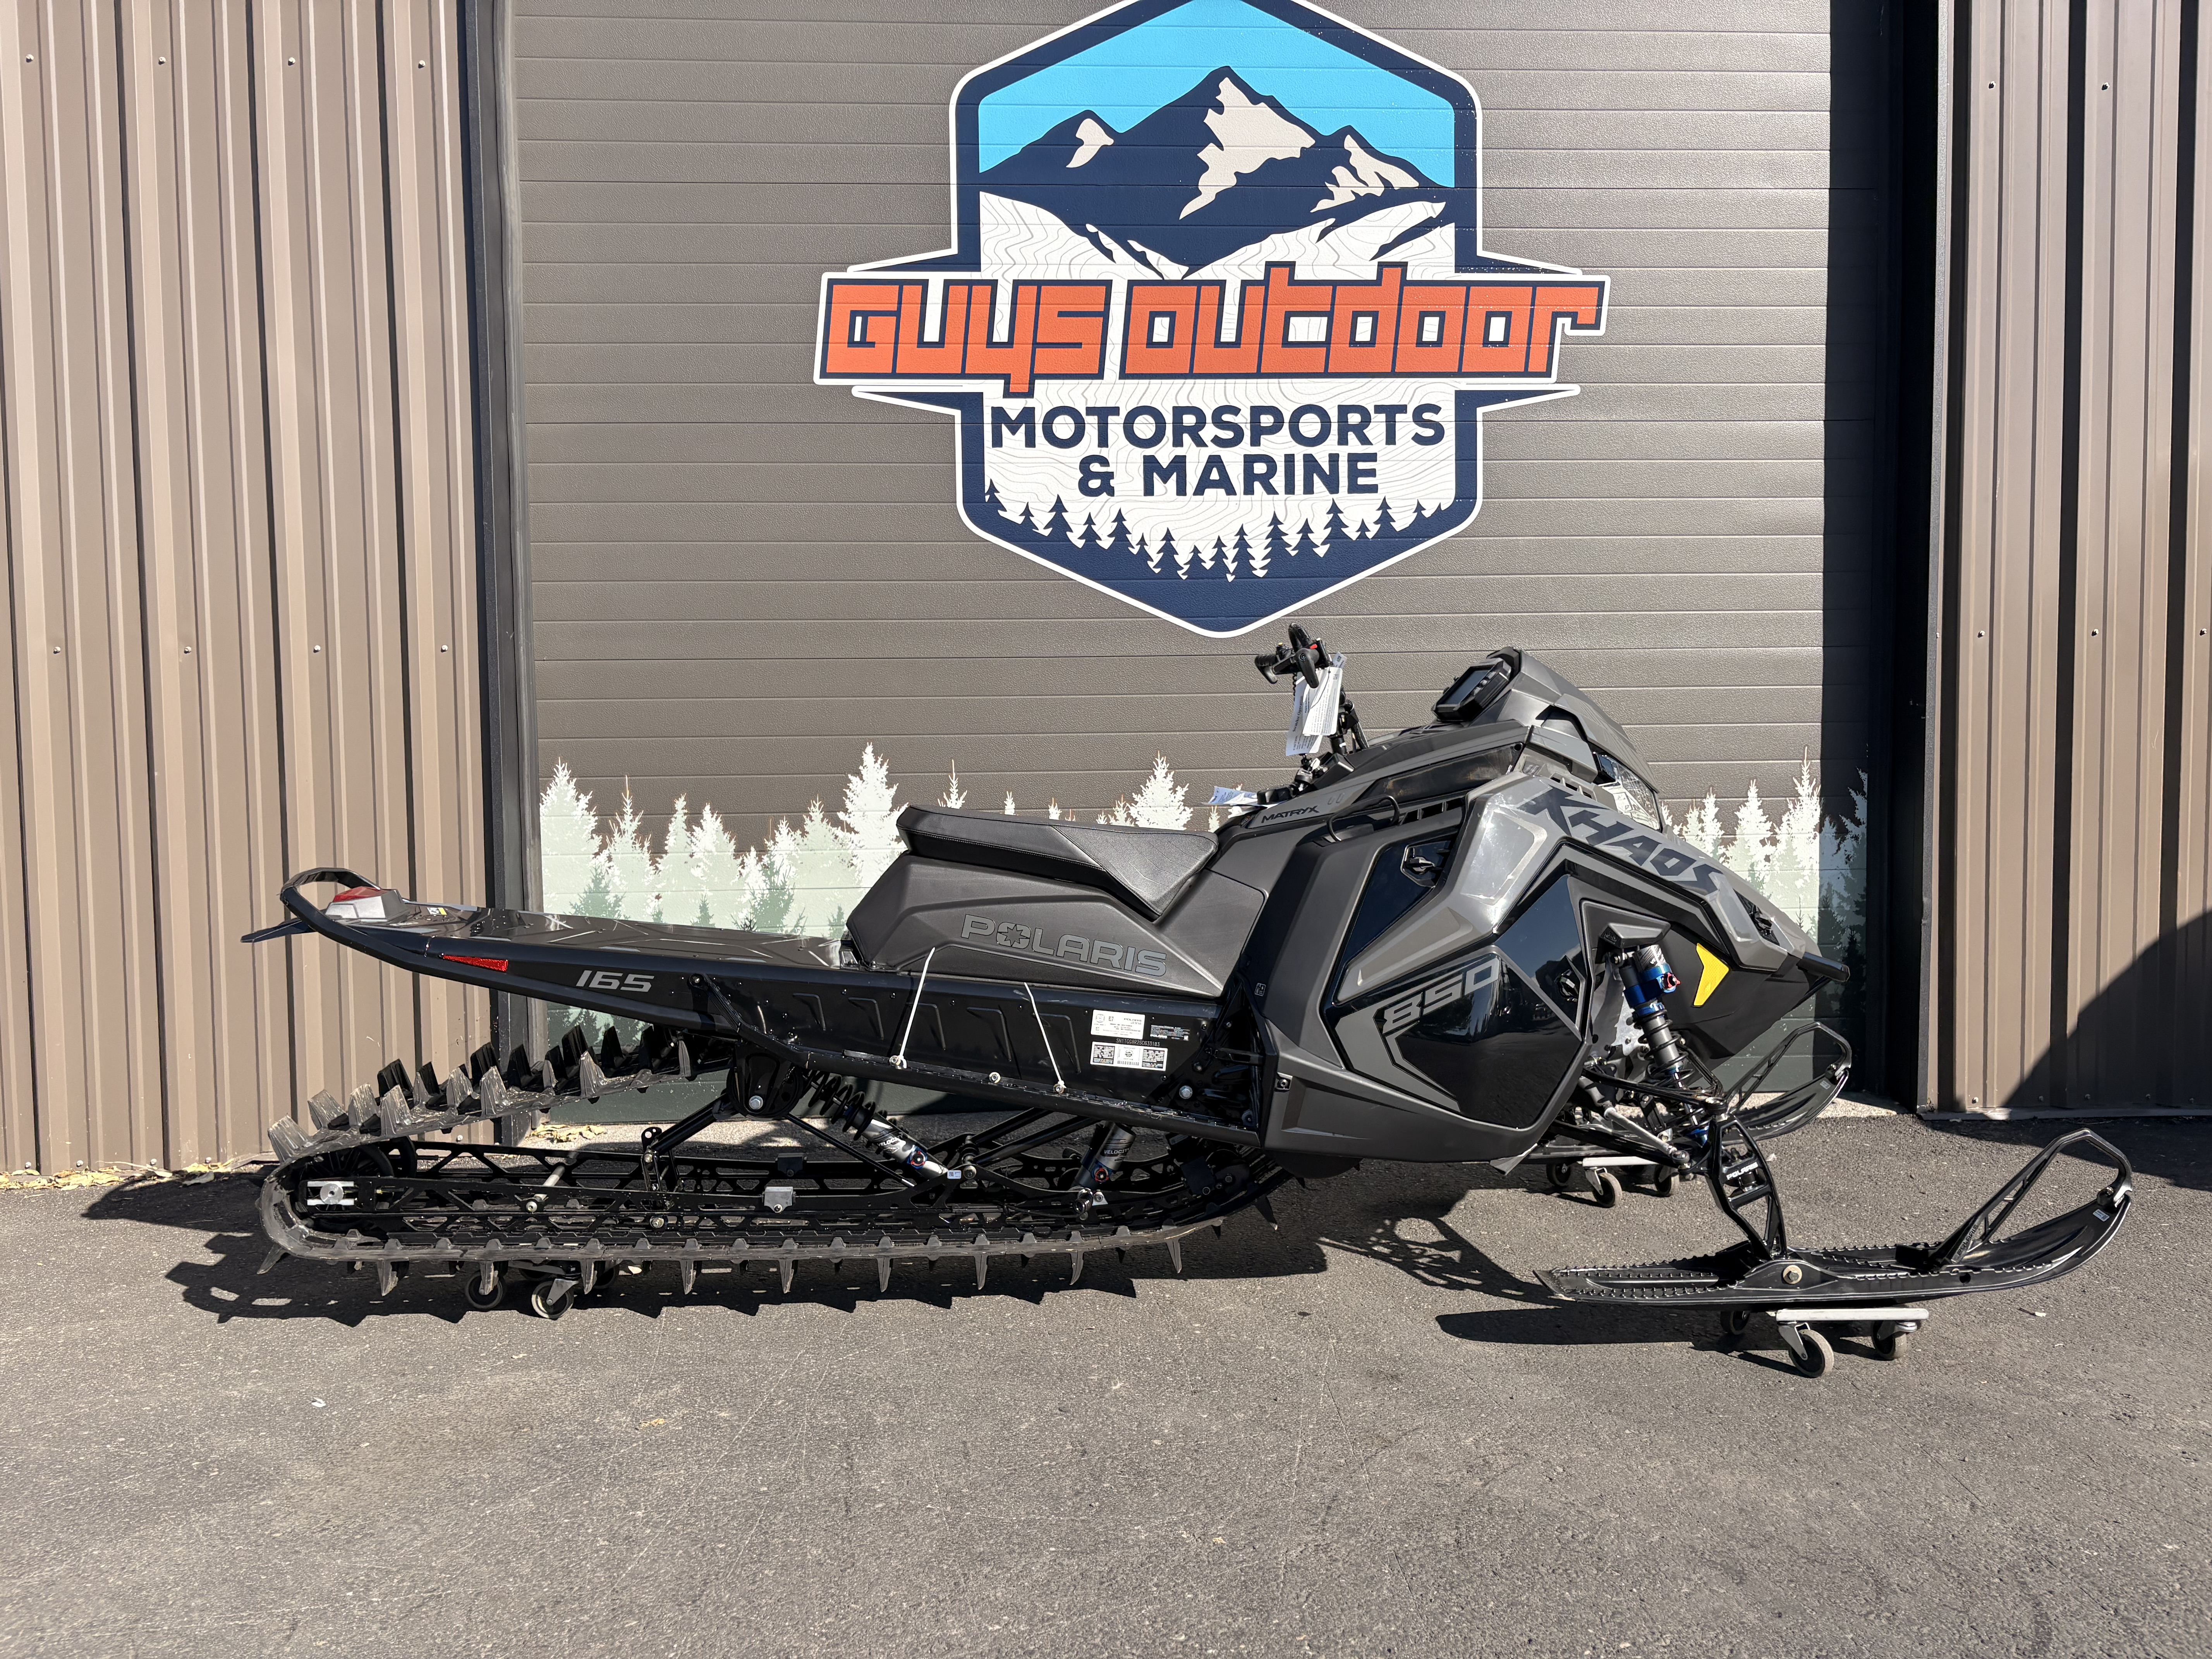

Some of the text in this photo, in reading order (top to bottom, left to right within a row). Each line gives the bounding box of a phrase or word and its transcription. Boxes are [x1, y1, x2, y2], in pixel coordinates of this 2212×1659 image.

[991, 404, 1445, 448] MOTORSPORTS
[1079, 453, 1379, 496] & MARINE
[1261, 805, 1320, 823] MATRYX
[1518, 787, 1723, 896] KHAOS
[961, 914, 1168, 977] POLARIS
[576, 970, 655, 992] 165
[1382, 957, 1499, 1034] 850
[1726, 1161, 1758, 1180] POLARIS
[1957, 1224, 1978, 1255] POLARIS
